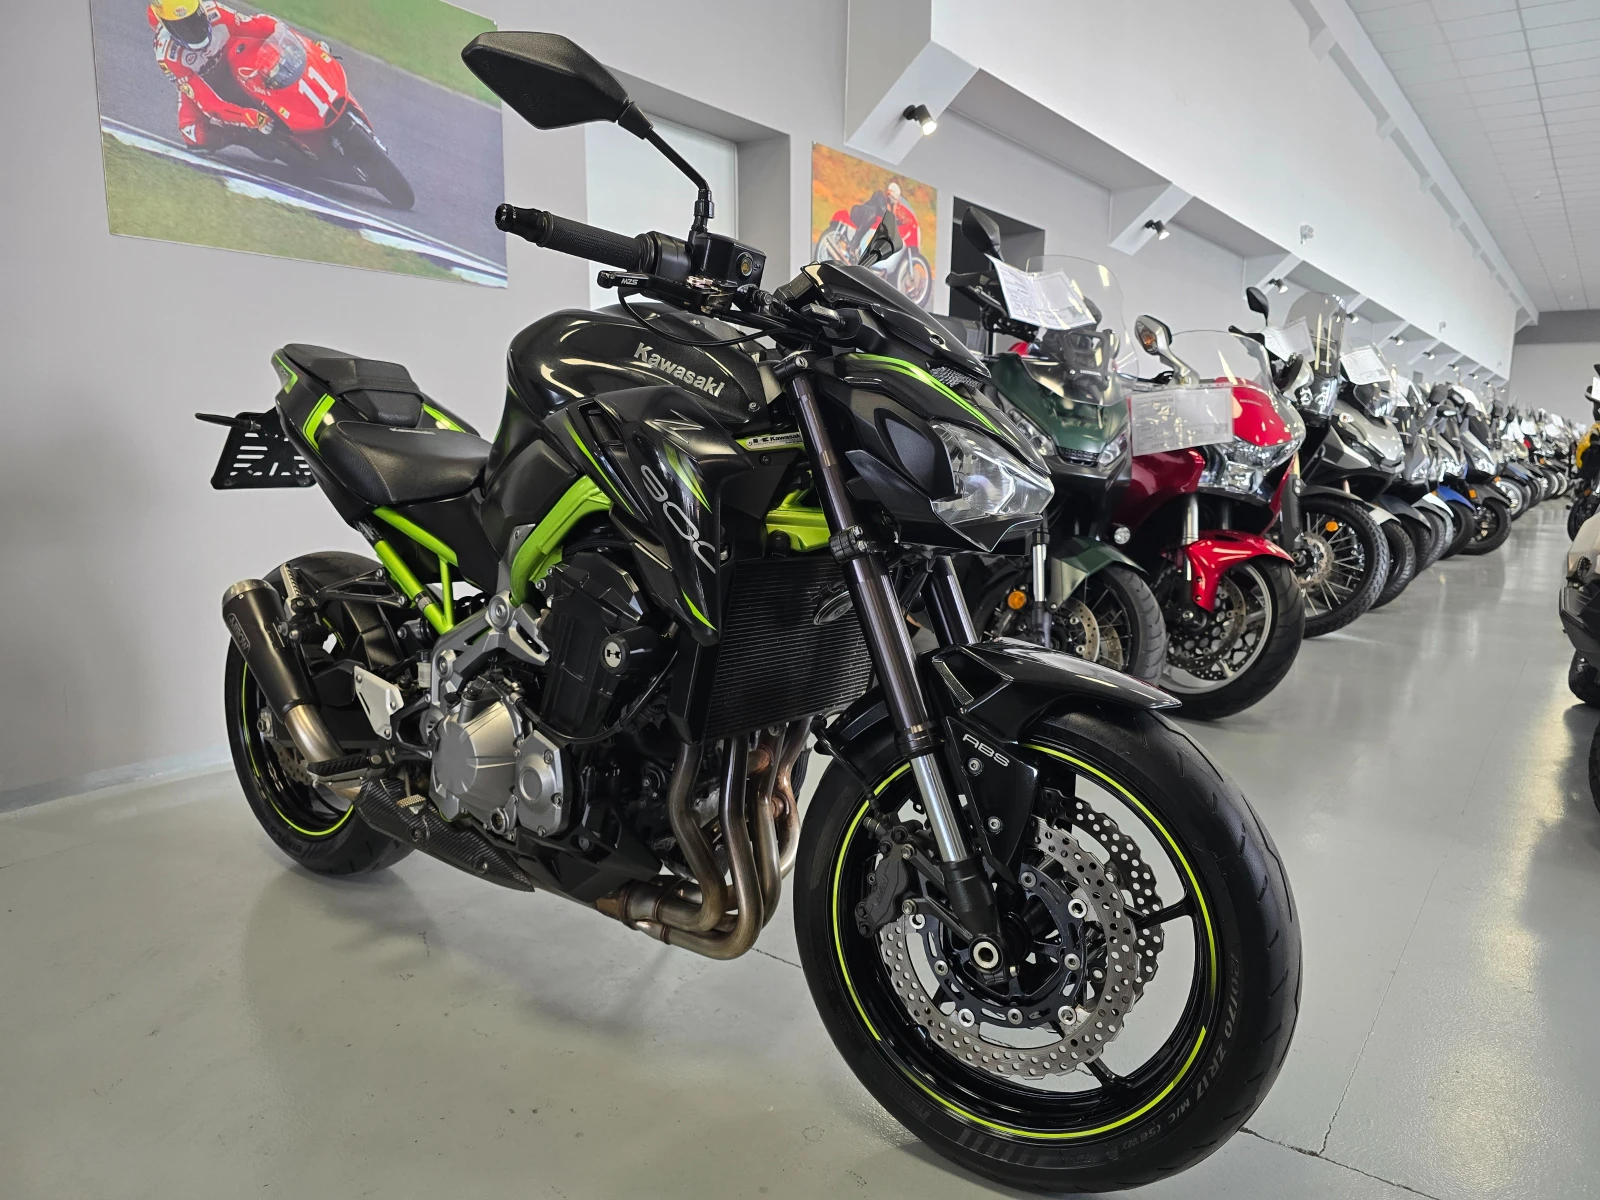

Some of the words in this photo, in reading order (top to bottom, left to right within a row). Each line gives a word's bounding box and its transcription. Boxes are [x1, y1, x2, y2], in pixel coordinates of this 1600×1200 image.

[298, 66, 339, 118] 11
[633, 341, 725, 398] Kawasaki
[769, 433, 802, 442] Kawasak
[962, 733, 1010, 767] ABS
[1195, 1041, 1228, 1101] ZR17
